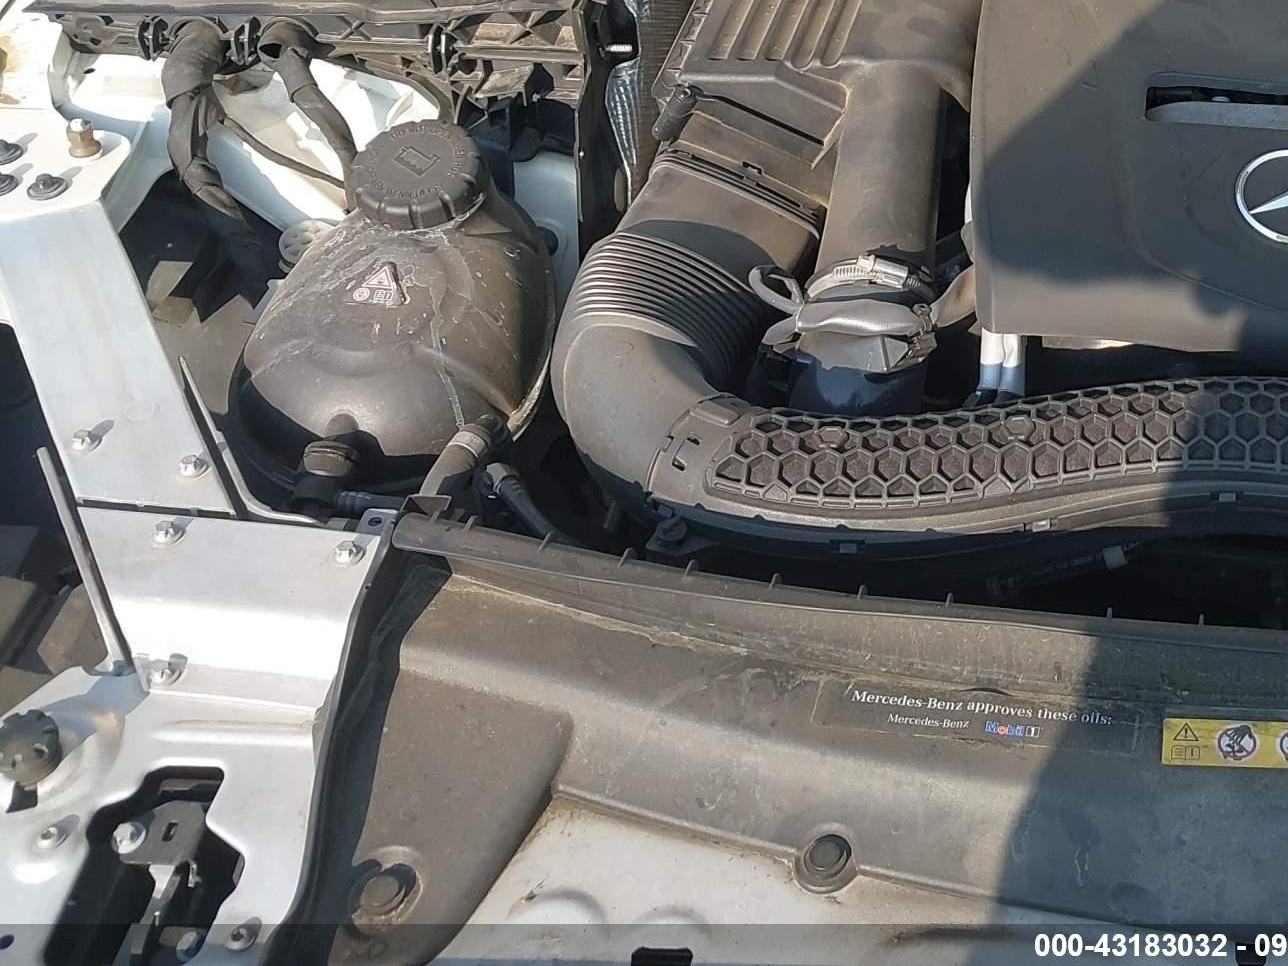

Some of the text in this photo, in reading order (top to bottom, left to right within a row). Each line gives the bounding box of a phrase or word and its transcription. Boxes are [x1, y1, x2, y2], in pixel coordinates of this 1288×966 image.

[851, 690, 1113, 725] Mercedes-Benz approves these oils:
[887, 713, 970, 729] Mercedes-Benz
[984, 720, 1025, 737] Mobil
